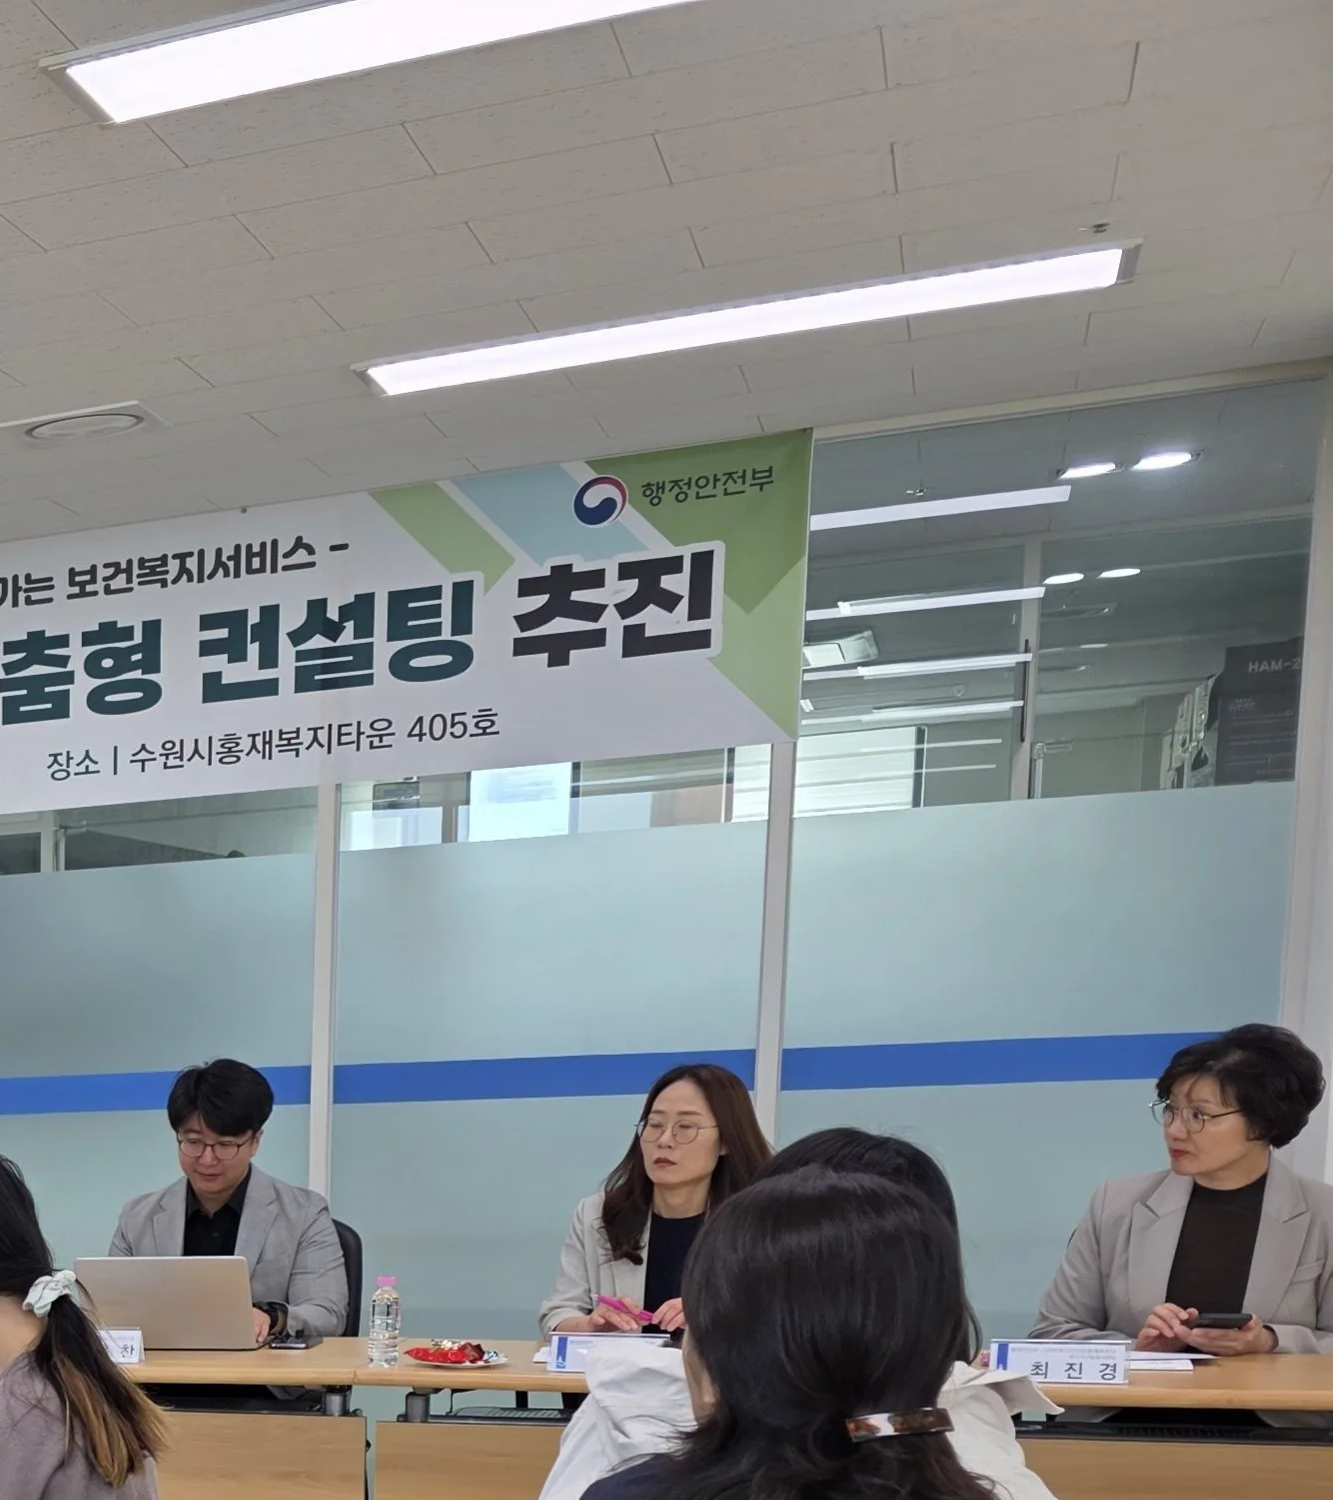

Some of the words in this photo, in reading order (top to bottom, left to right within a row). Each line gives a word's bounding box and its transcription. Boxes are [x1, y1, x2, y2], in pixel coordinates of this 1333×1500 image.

[641, 465, 775, 507] 행정안전부
[66, 536, 317, 602] 보건복지서비스
[198, 580, 476, 705] 컨설팅
[512, 548, 716, 669] 추진
[47, 749, 101, 782] 장소
[129, 717, 396, 774] 수원시홍재복지타운
[407, 708, 501, 745] 405호
